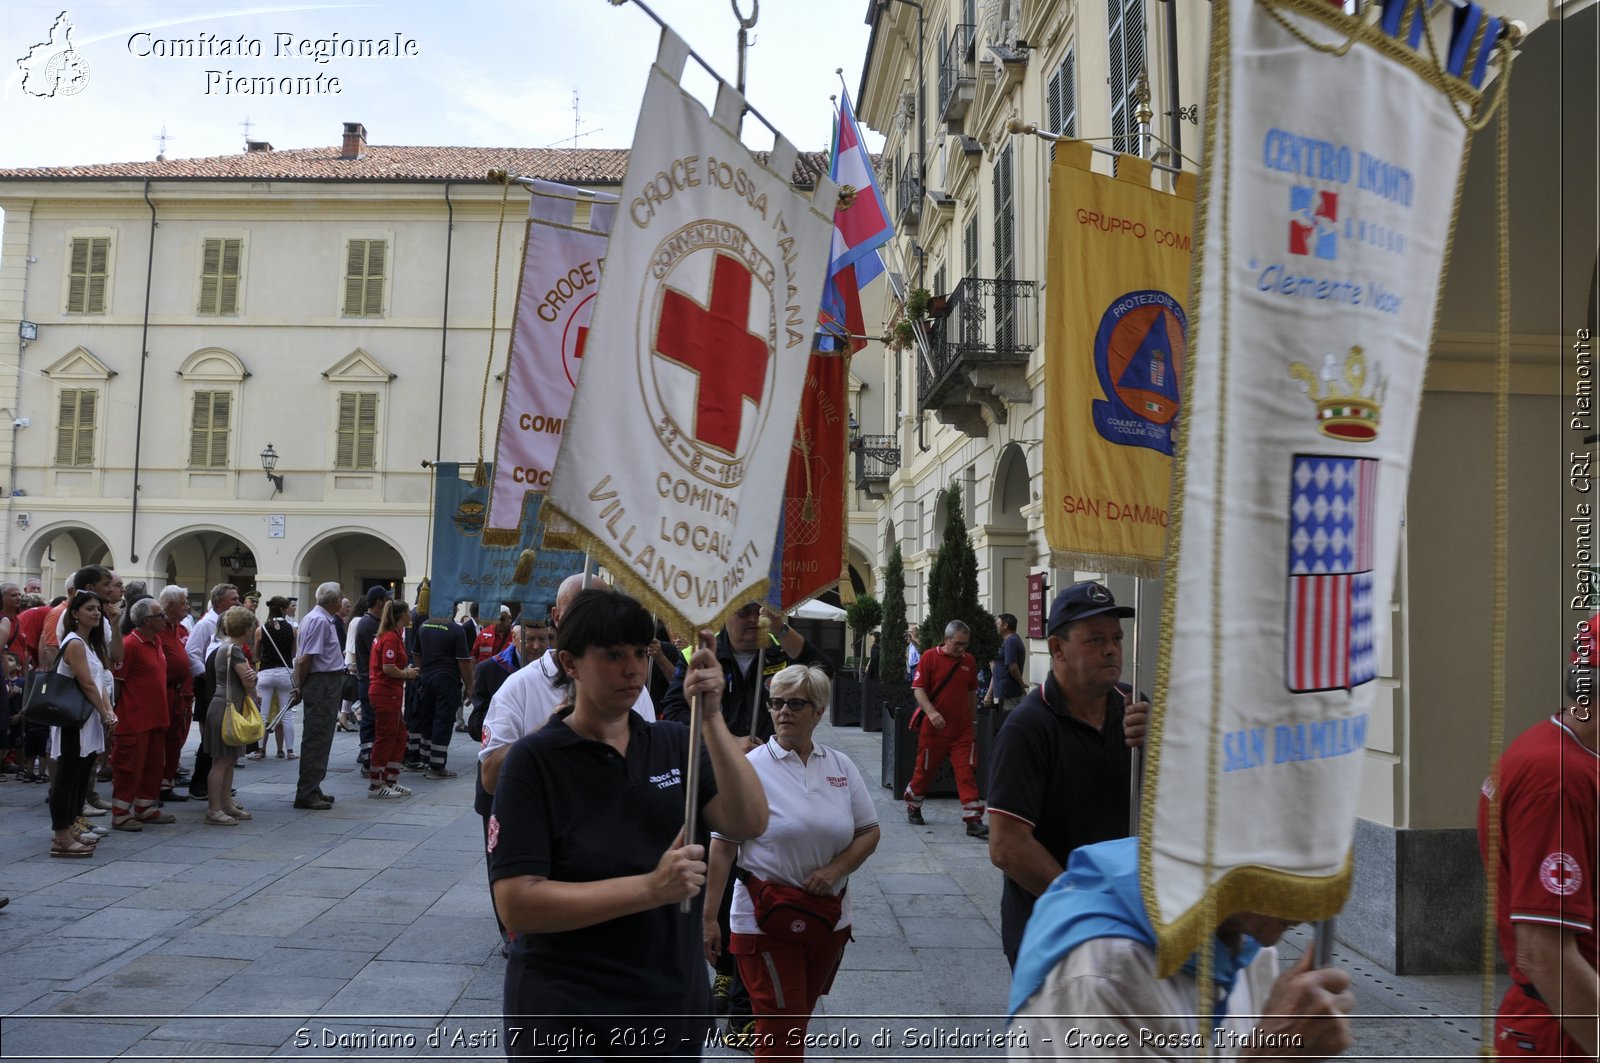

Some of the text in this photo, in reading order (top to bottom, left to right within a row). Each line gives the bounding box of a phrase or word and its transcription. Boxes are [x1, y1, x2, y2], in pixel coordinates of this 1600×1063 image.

[1264, 127, 1353, 185] CENTRO
[630, 156, 700, 229] CROCE
[707, 157, 768, 221] ROSSA
[1077, 208, 1147, 239] GRUPPO
[537, 261, 597, 323] CROCE
[1063, 495, 1101, 517] SAN
[589, 474, 720, 608] VILLANOVA
[1223, 728, 1266, 773] SAN
